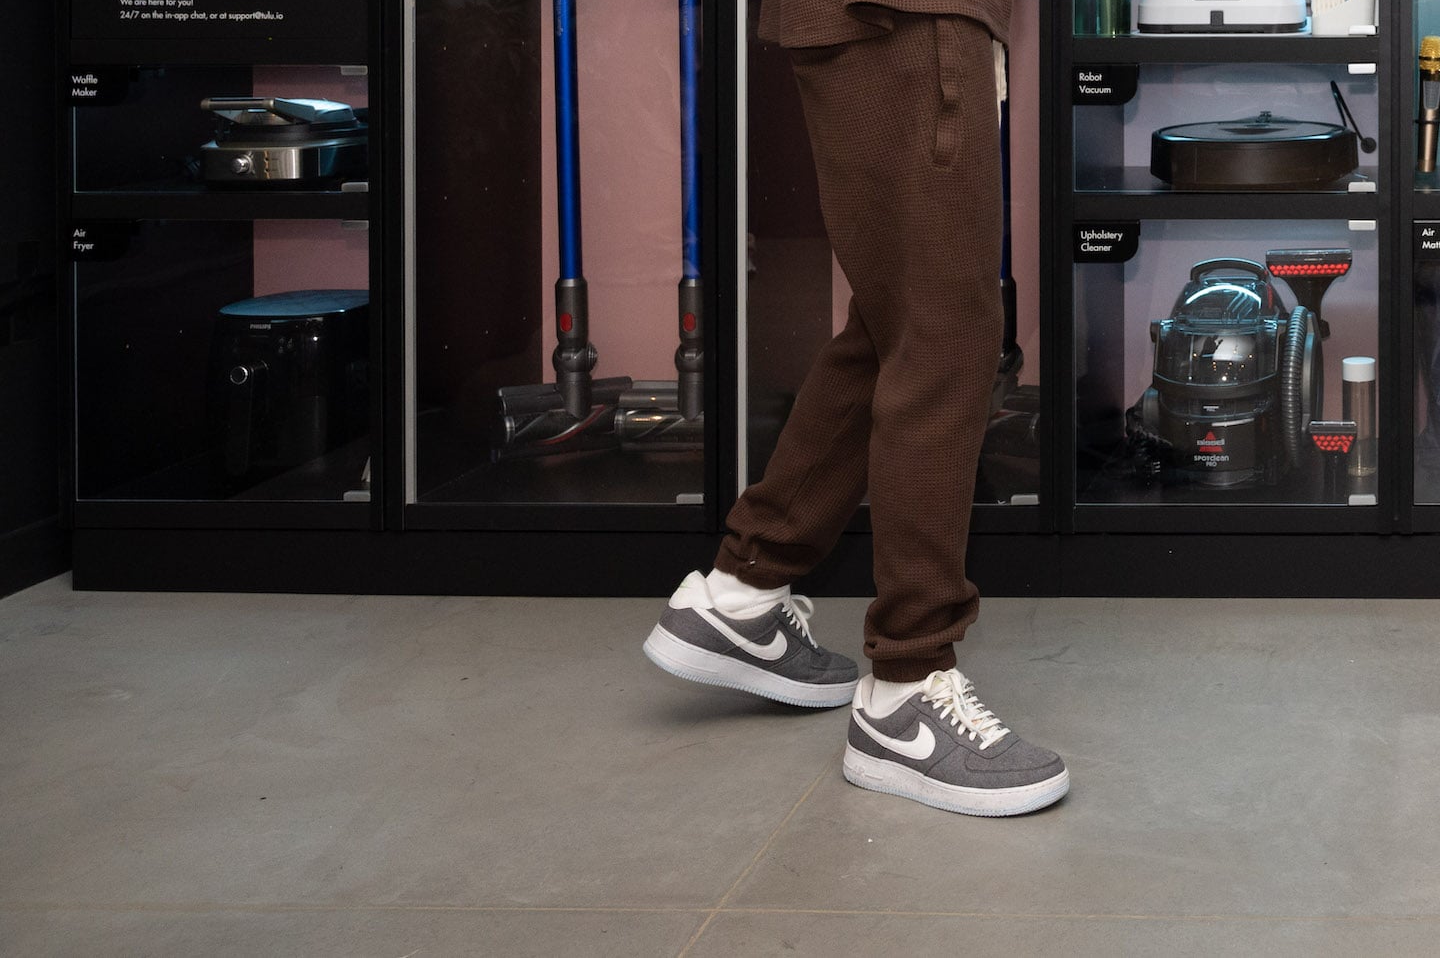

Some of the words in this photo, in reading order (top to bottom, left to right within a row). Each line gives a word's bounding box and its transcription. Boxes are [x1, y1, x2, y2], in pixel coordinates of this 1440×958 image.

[120, 9, 139, 19] 24/7
[152, 9, 163, 19] the
[165, 10, 189, 22] in-app
[190, 10, 208, 21] chat,
[219, 12, 227, 20] at
[229, 10, 283, 22] support@tulu.io
[71, 73, 99, 85] Waffle
[1078, 71, 1103, 82] Robot
[71, 86, 97, 97] Maker
[1078, 85, 1112, 94] Vacuum
[73, 228, 87, 238] Air
[1080, 229, 1123, 242] Upholstery
[1421, 227, 1436, 237] Air
[73, 240, 95, 253] Fryer
[1080, 242, 1113, 252] Cleaner
